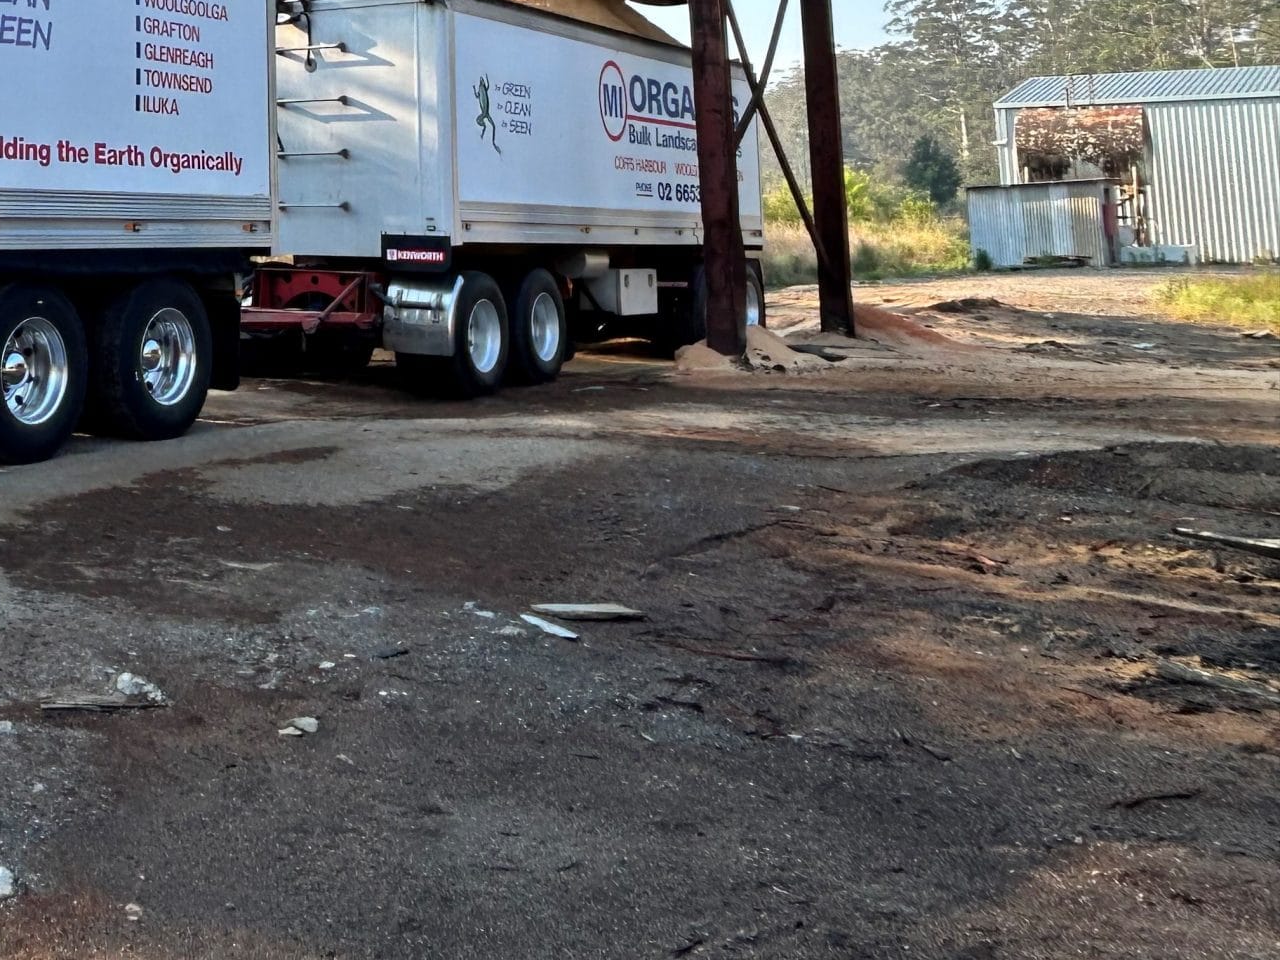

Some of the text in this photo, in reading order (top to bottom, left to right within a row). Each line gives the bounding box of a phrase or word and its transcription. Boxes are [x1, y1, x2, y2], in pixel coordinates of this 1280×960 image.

[143, 17, 200, 42] GRAFTON
[144, 43, 213, 69] GLENREAGH
[143, 69, 212, 94] TOWNSEND
[503, 82, 531, 99] GREEN
[143, 95, 179, 116] ILUKA
[603, 83, 623, 119] MI
[509, 119, 531, 136] SEEN
[628, 124, 697, 152] Bulk Landsca
[57, 140, 89, 164] the
[94, 142, 145, 167] Earth
[150, 146, 243, 176] Organically
[657, 181, 672, 202] 02
